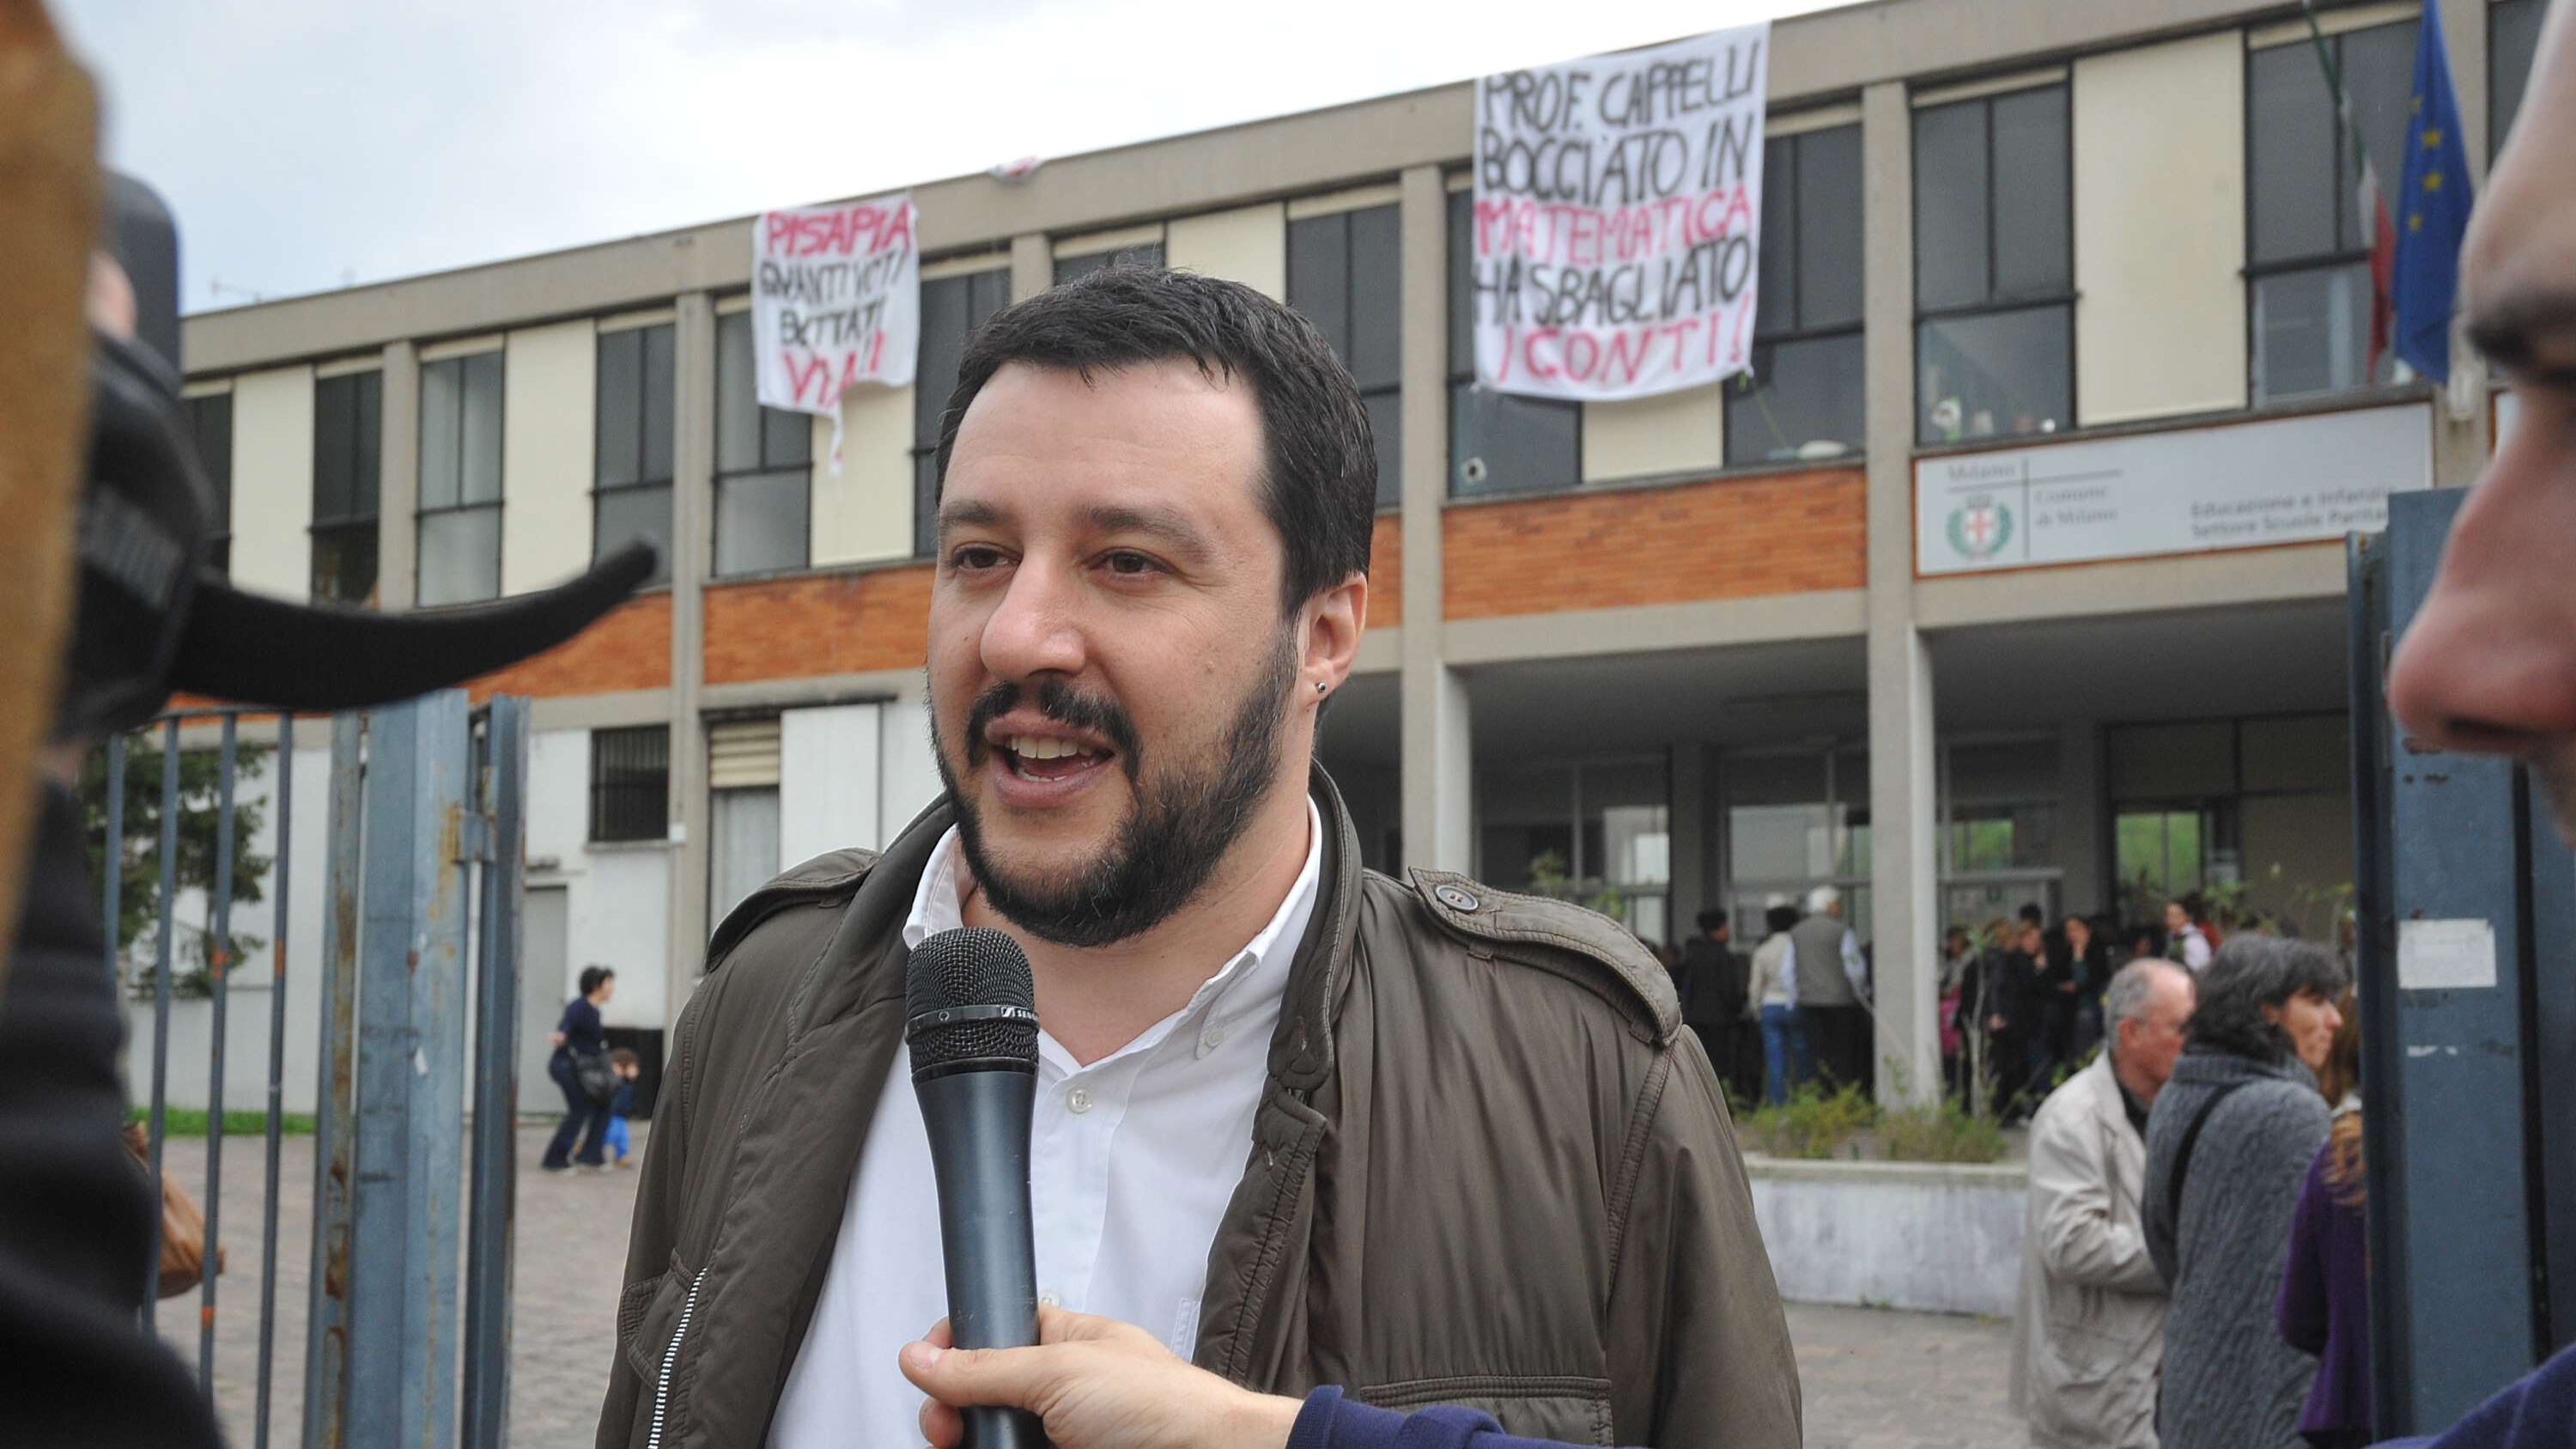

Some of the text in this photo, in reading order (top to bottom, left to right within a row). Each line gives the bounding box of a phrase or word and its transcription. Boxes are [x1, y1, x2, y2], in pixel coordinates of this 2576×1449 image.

[1600, 40, 1761, 126] CAPPELLI
[1480, 113, 1754, 205] BOCCIATO IN
[766, 200, 912, 256] PISAPIA
[1474, 184, 1753, 265] MATEMATICA
[1474, 235, 1752, 326] HA SBAGLIATO
[1947, 464, 2015, 480] Milano
[2034, 486, 2110, 504] Comune
